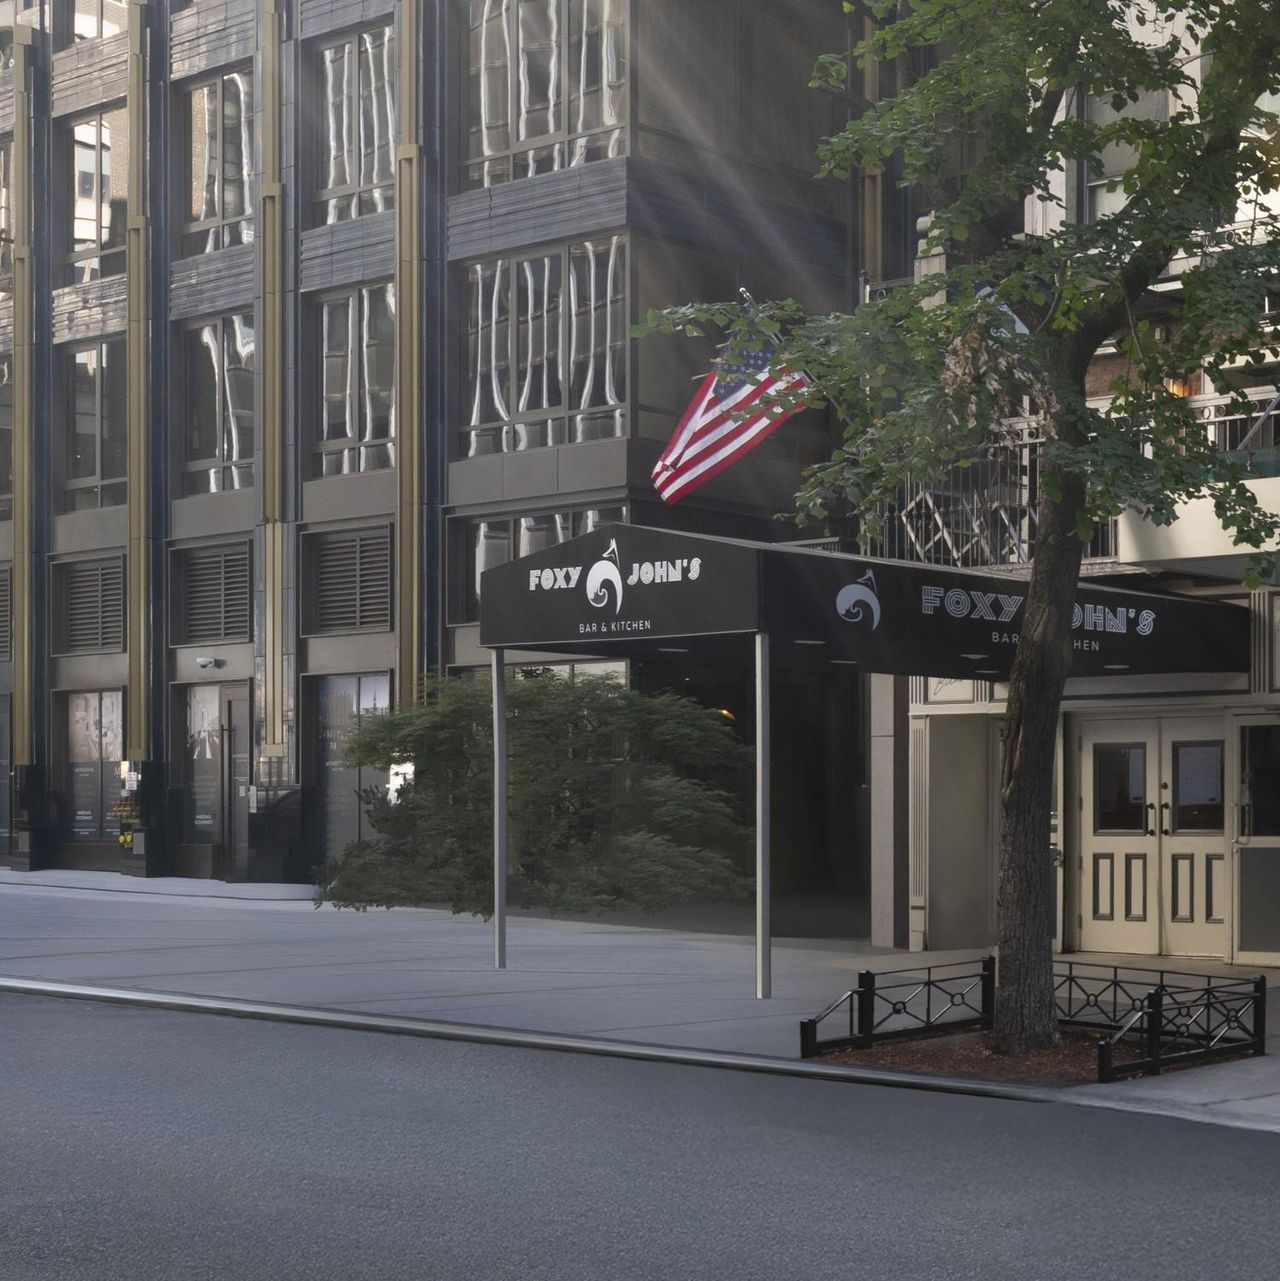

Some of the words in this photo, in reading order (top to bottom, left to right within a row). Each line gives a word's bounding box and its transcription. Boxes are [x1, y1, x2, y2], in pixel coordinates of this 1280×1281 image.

[529, 566, 582, 591] FOXY
[626, 557, 702, 586] JOHN'S
[922, 585, 1024, 622] FOXY
[1071, 602, 1156, 636] HN'S
[579, 623, 597, 633] BAR
[601, 622, 607, 632] &
[611, 620, 651, 631] KITCHEN
[992, 631, 1020, 645] BAR
